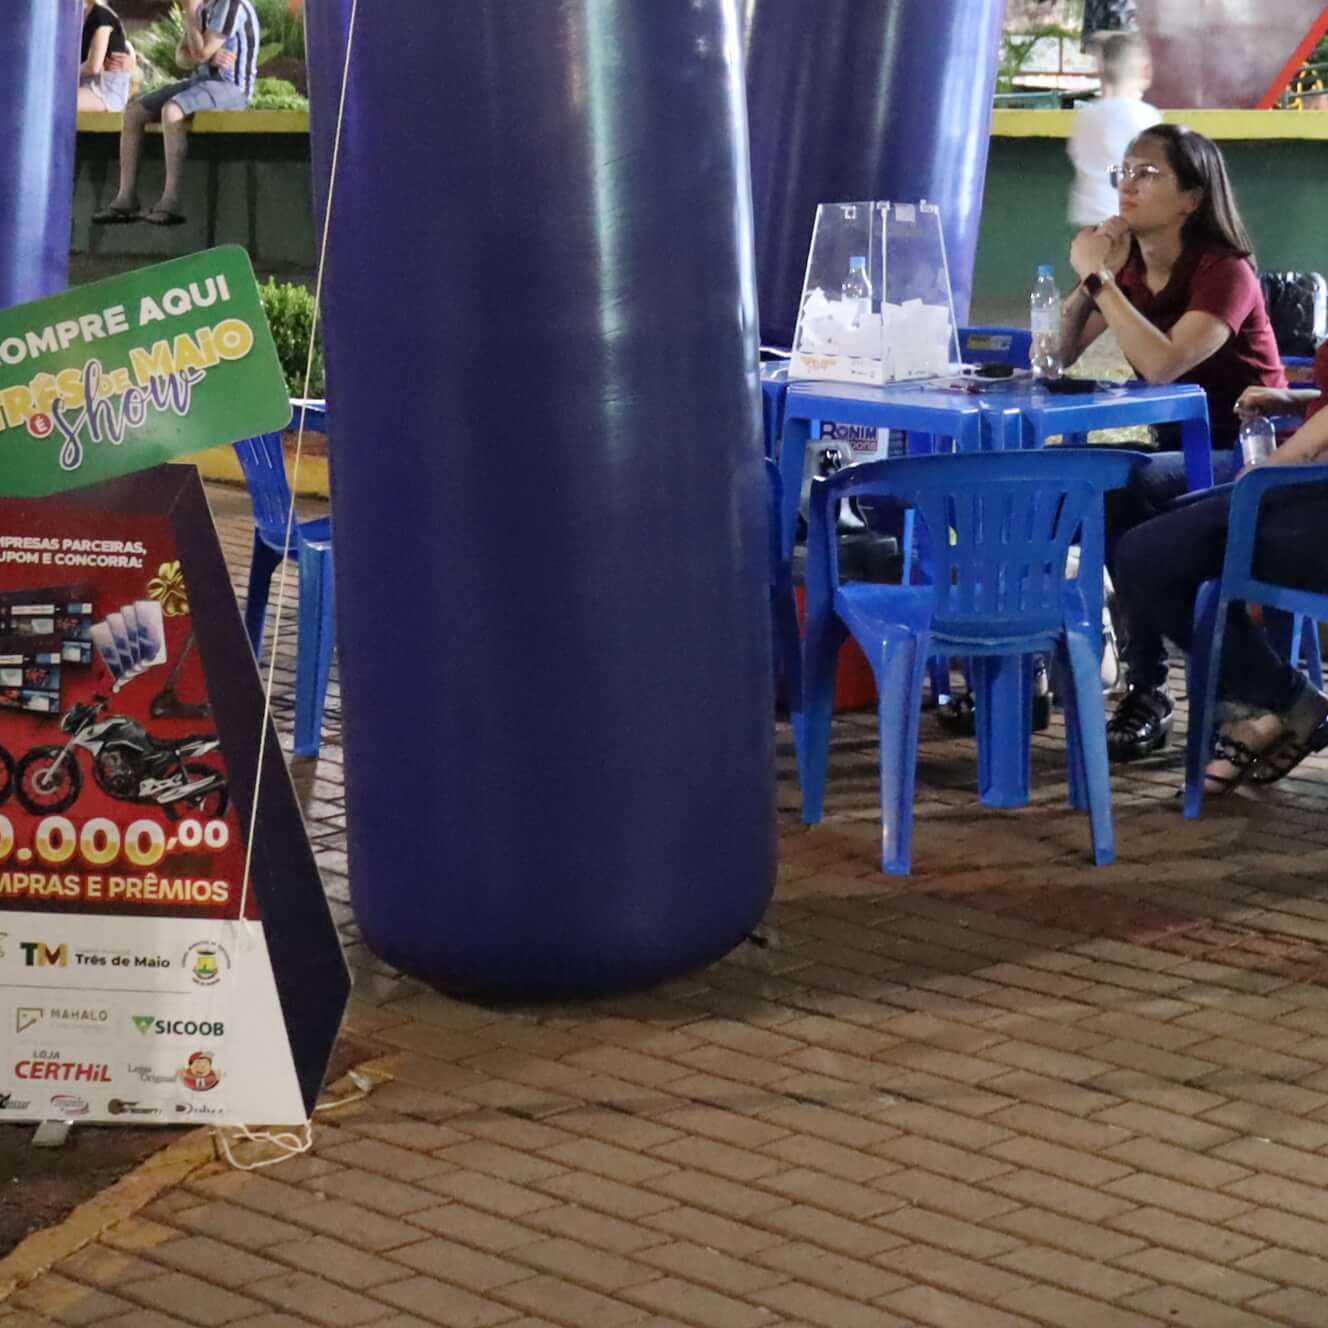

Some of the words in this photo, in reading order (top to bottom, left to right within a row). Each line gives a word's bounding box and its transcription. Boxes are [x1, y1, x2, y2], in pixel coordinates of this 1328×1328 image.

[139, 274, 231, 325] AQUI
[61, 538, 147, 556] PARCEIRAS,
[42, 552, 52, 565] E
[54, 553, 143, 569] CONCORRA:
[87, 876, 102, 897] E
[108, 872, 229, 902] PRÊMIOS
[20, 941, 69, 969] TM
[75, 953, 107, 967] Três
[111, 955, 131, 968] de
[134, 956, 171, 970] Maio
[50, 1007, 109, 1022] MAHALO
[154, 1019, 225, 1037] SICOOB
[33, 1049, 61, 1060] LOJA
